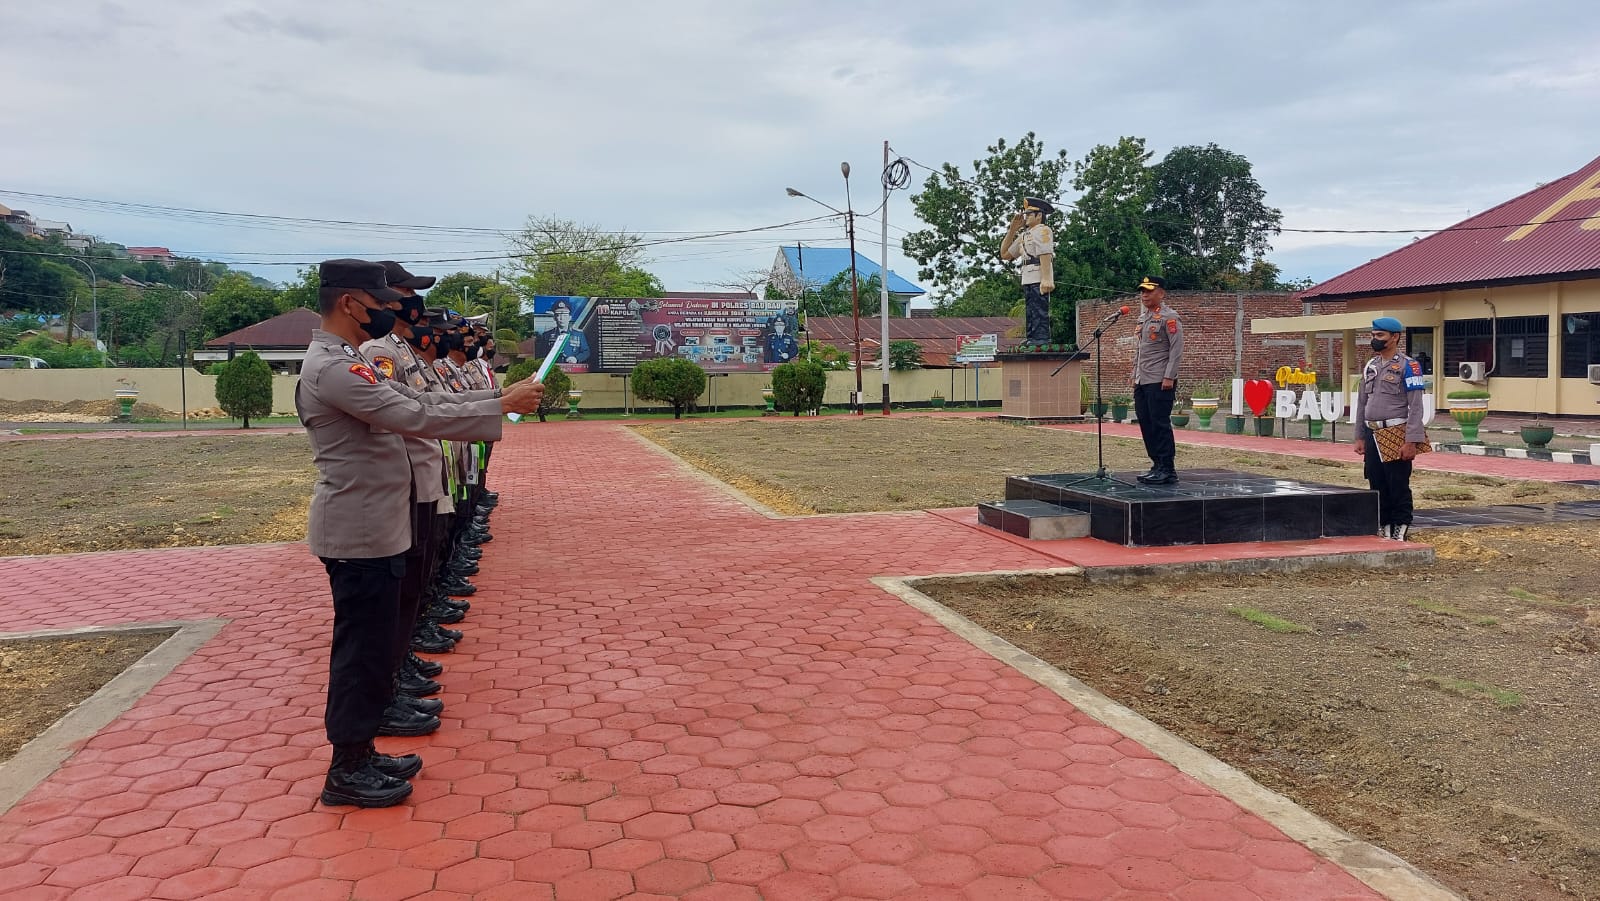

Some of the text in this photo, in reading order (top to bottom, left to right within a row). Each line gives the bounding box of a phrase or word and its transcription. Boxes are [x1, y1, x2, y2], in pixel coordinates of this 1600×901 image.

[721, 301, 749, 309] POLRES
[750, 302, 765, 310] BAU
[767, 302, 781, 310] BAU
[1232, 379, 1244, 415] I
[1275, 390, 1345, 422] BAU
